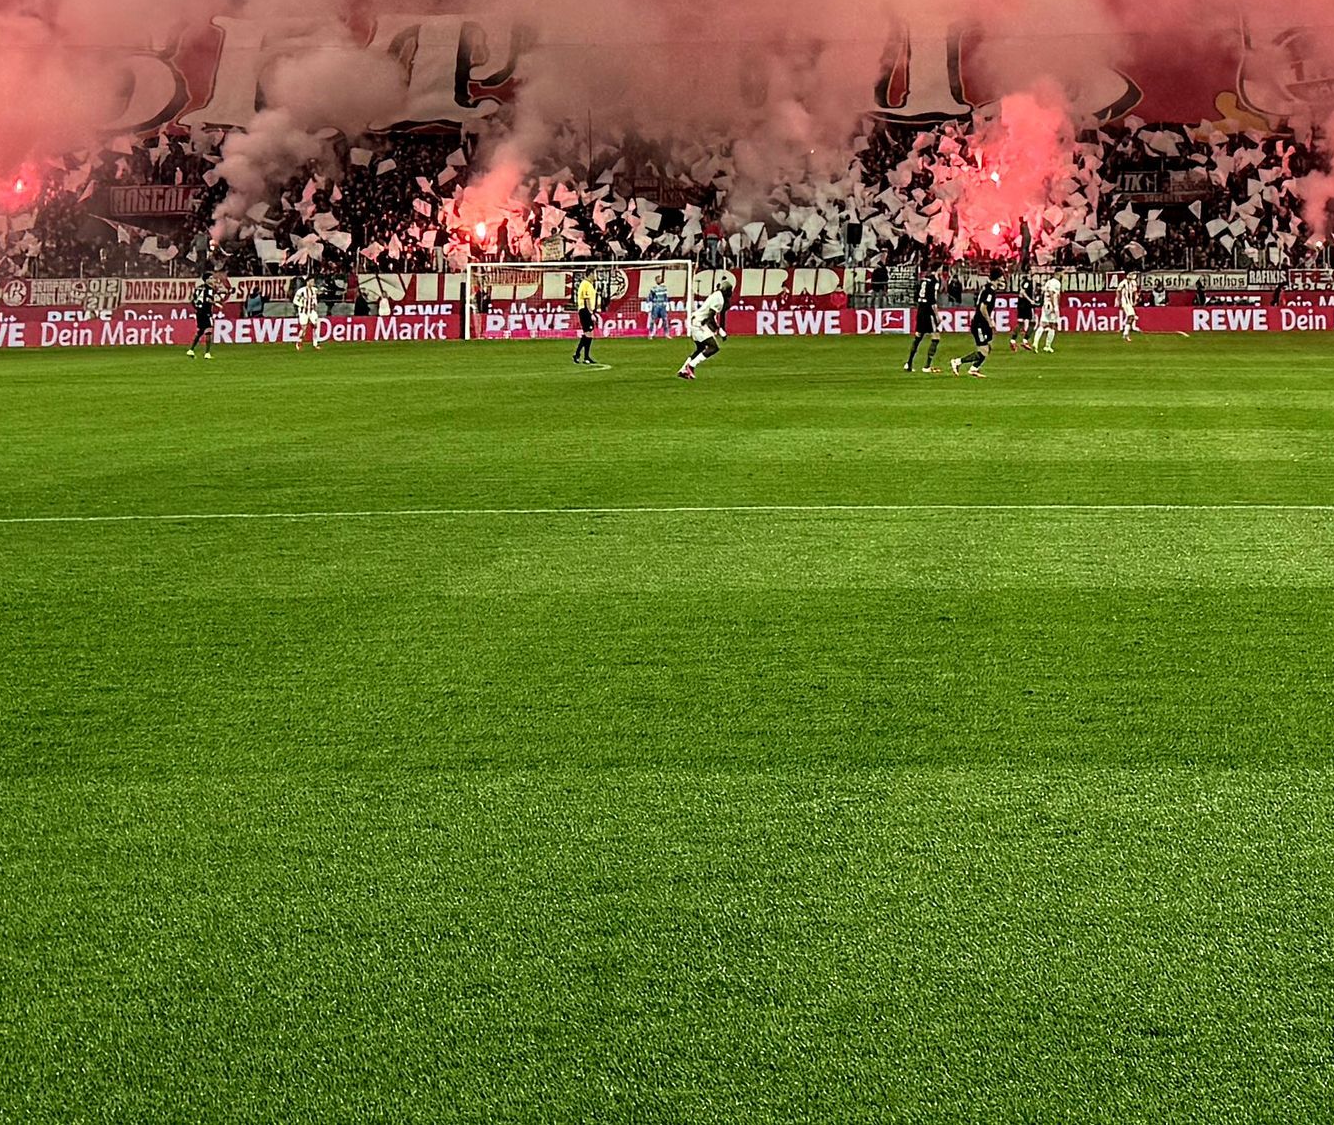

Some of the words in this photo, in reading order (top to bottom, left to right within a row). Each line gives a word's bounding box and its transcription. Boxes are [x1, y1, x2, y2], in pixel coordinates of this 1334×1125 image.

[125, 279, 196, 302] DOMSTADT
[756, 310, 842, 335] REWE
[938, 310, 1011, 332] REE
[1193, 309, 1269, 331] REWE
[1280, 307, 1327, 331] Dein
[40, 323, 93, 347] Dein
[100, 321, 174, 346] Markt
[213, 318, 300, 344] REWE
[317, 316, 368, 342] Dein
[374, 316, 448, 341] Markt
